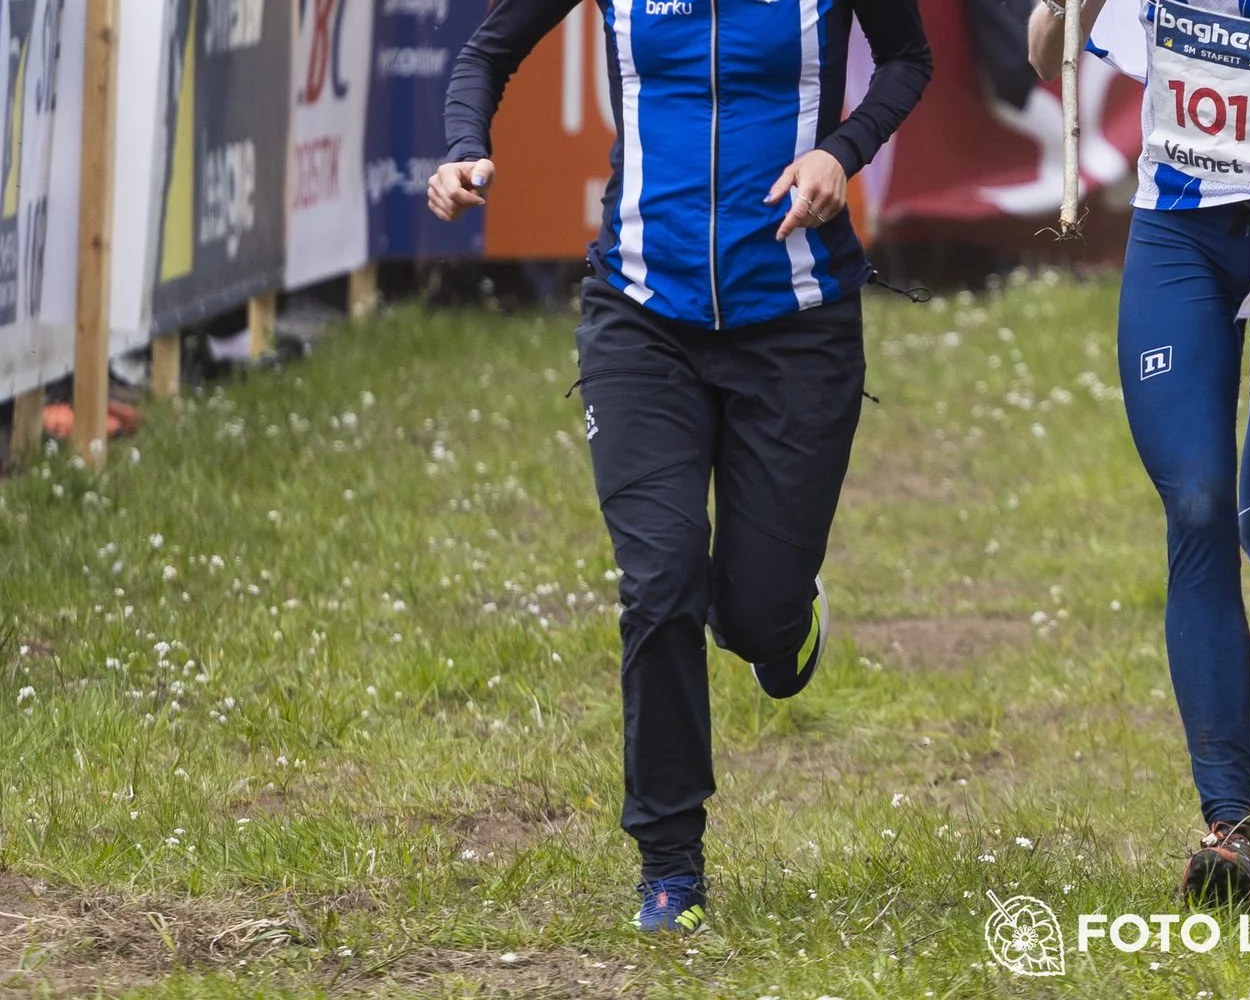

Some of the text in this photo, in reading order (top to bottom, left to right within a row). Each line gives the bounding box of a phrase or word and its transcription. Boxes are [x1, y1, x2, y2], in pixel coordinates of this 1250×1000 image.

[1183, 45, 1196, 55] SM
[1201, 50, 1241, 65] STAFETT
[1168, 80, 1248, 142] 101
[1164, 139, 1243, 173] Valmet
